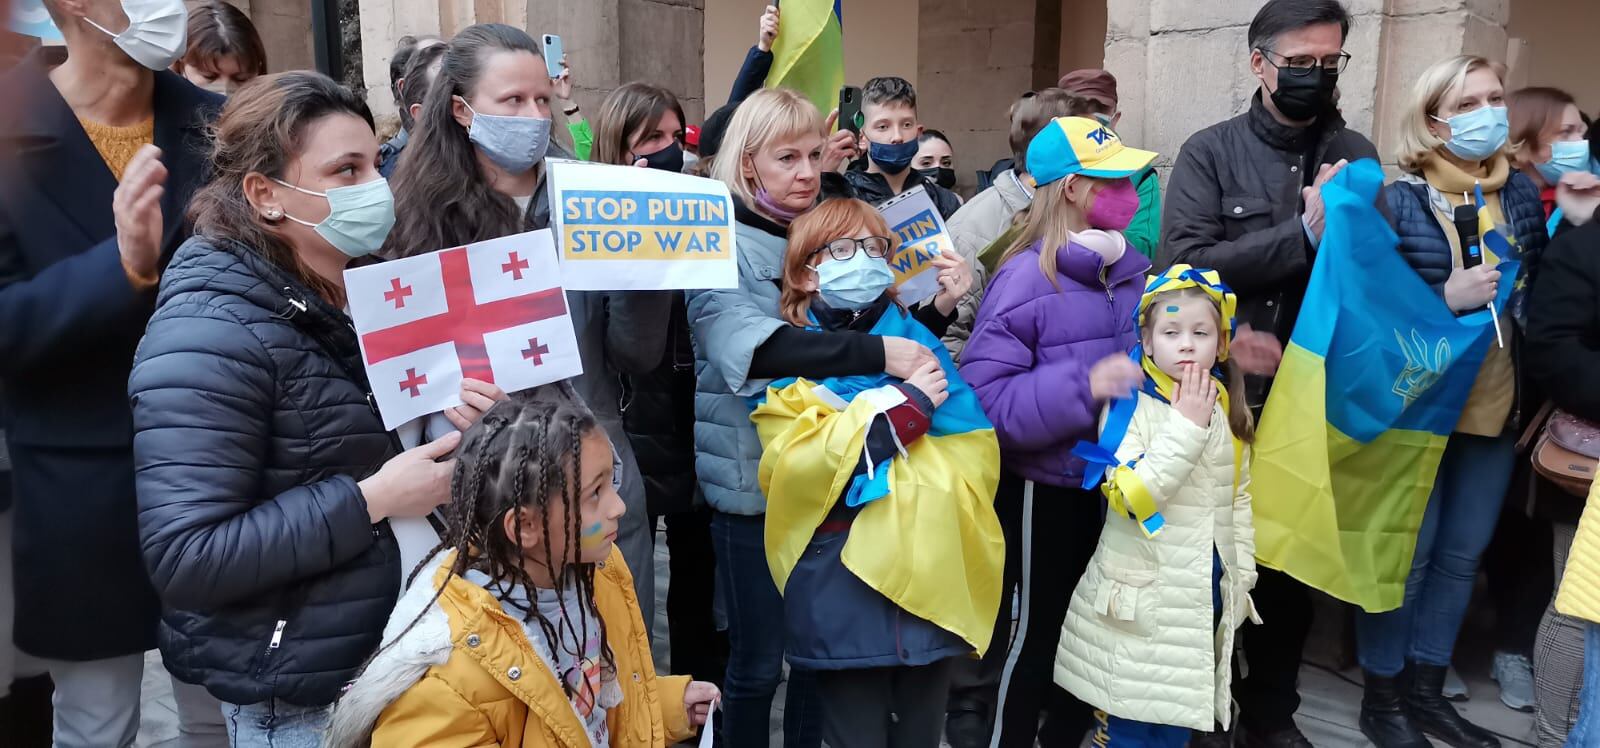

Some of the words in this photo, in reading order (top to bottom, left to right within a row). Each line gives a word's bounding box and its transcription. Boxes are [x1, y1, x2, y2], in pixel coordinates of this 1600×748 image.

[566, 197, 637, 221] STOP
[648, 198, 725, 222] PUTIN
[571, 230, 642, 252] STOP
[654, 231, 722, 252] WAR
[892, 241, 942, 274] WAR
